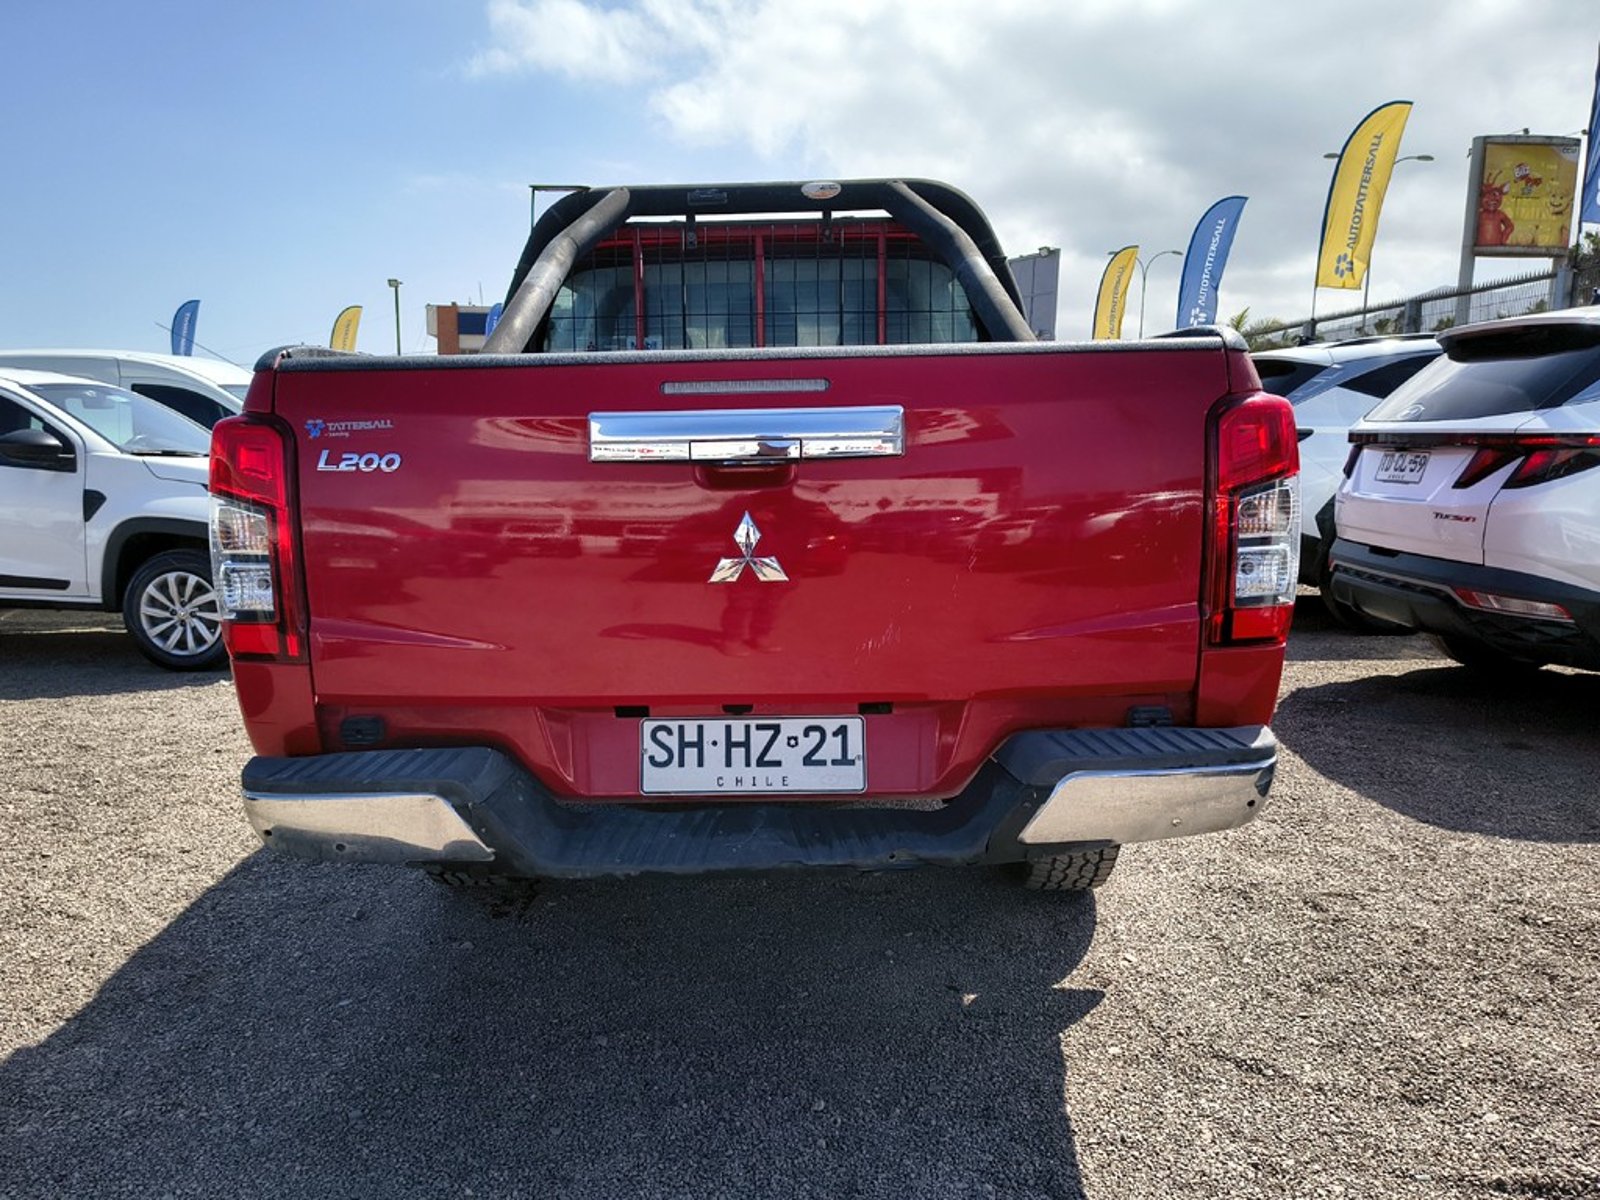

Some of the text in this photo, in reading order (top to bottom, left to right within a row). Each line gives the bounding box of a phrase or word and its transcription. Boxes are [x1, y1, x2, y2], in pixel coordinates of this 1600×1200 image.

[1346, 131, 1384, 250] AUTOTATTERSALL
[1198, 217, 1226, 307] AUTOTATTERSALL
[327, 420, 393, 431] TATTERSALL
[317, 449, 402, 473] L200
[716, 775, 789, 787] CHILE
